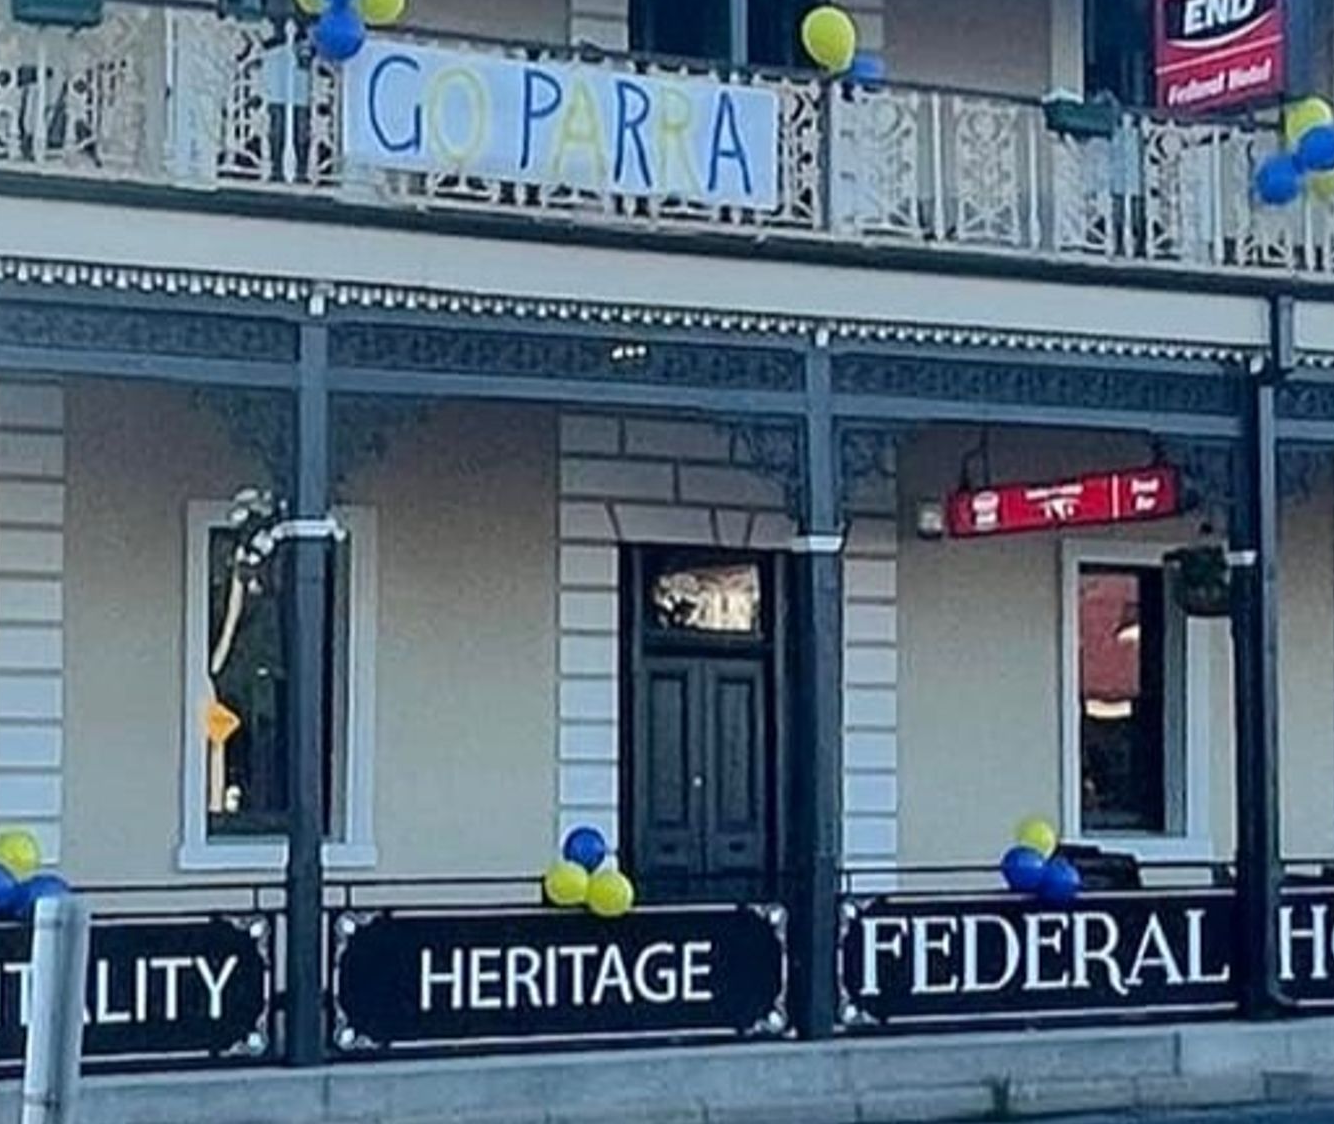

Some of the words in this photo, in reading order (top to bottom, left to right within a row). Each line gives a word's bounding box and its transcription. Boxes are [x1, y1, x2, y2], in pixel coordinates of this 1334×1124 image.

[368, 54, 491, 160] GO
[520, 69, 752, 195] PARRA
[419, 940, 713, 1011] HERITAGE
[859, 908, 1232, 997] FEDERAL
